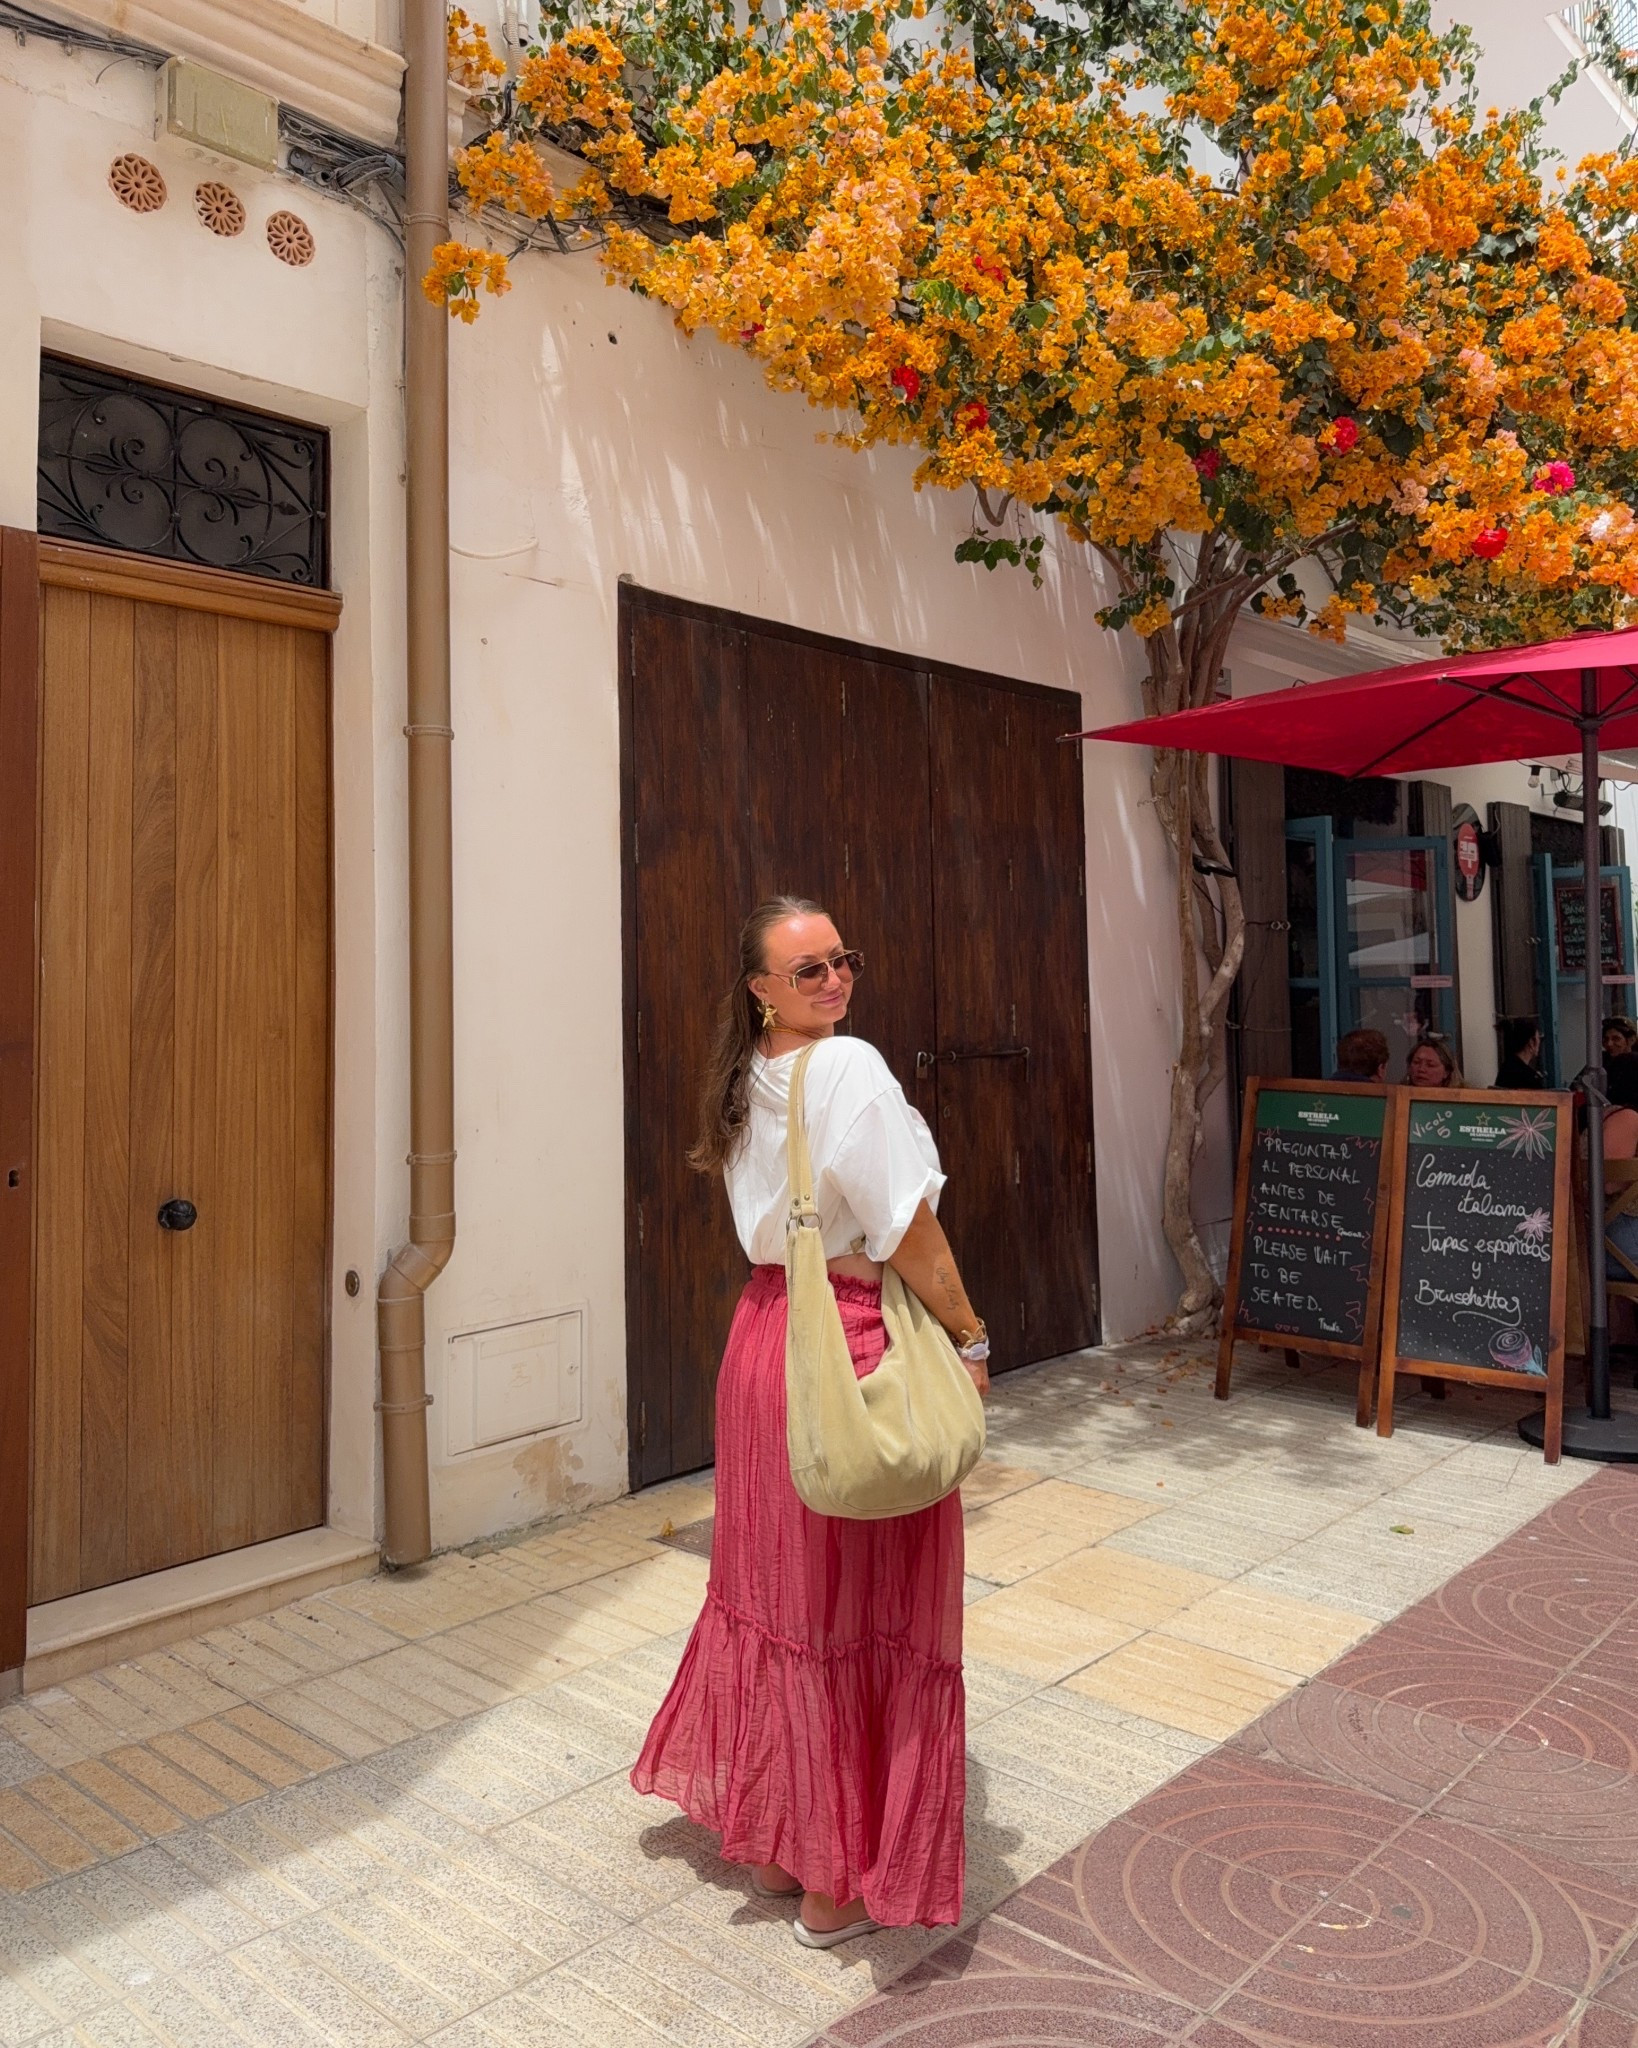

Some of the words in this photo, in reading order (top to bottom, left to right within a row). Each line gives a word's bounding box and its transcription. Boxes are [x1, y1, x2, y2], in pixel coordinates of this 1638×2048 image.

[1298, 1111, 1340, 1121] ESTRELLA
[1458, 1125, 1507, 1135] ESTRELLA
[1264, 1136, 1351, 1159] PREGUNTAR
[1262, 1159, 1280, 1173] AL
[1288, 1161, 1361, 1185] PERSONAL
[1416, 1153, 1491, 1190] Comida
[1260, 1182, 1305, 1200] ANTES
[1317, 1189, 1336, 1206] DE
[1457, 1189, 1530, 1217] italiana
[1257, 1202, 1344, 1228] SENTARSE
[1411, 1211, 1469, 1256] Tapas
[1253, 1235, 1308, 1261] PLEASE
[1250, 1262, 1270, 1279] TO
[1277, 1267, 1303, 1285] BE
[1250, 1286, 1322, 1312] SEATED.
